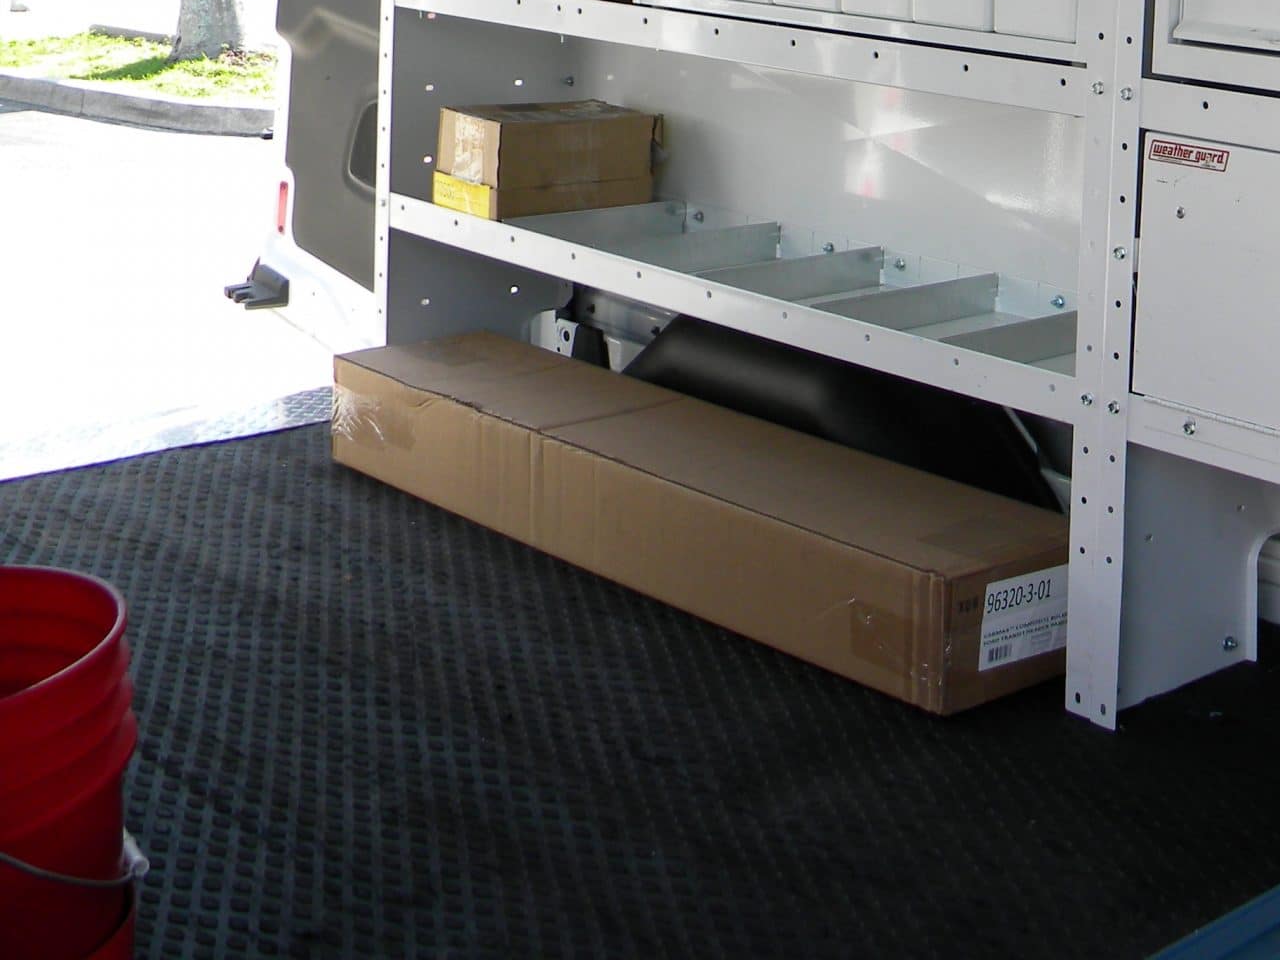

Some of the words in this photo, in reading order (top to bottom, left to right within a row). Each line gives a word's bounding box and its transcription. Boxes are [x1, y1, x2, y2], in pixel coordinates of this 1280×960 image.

[1152, 143, 1195, 160] weather
[1194, 150, 1224, 166] guard
[986, 578, 1052, 614] 96320-3-01
